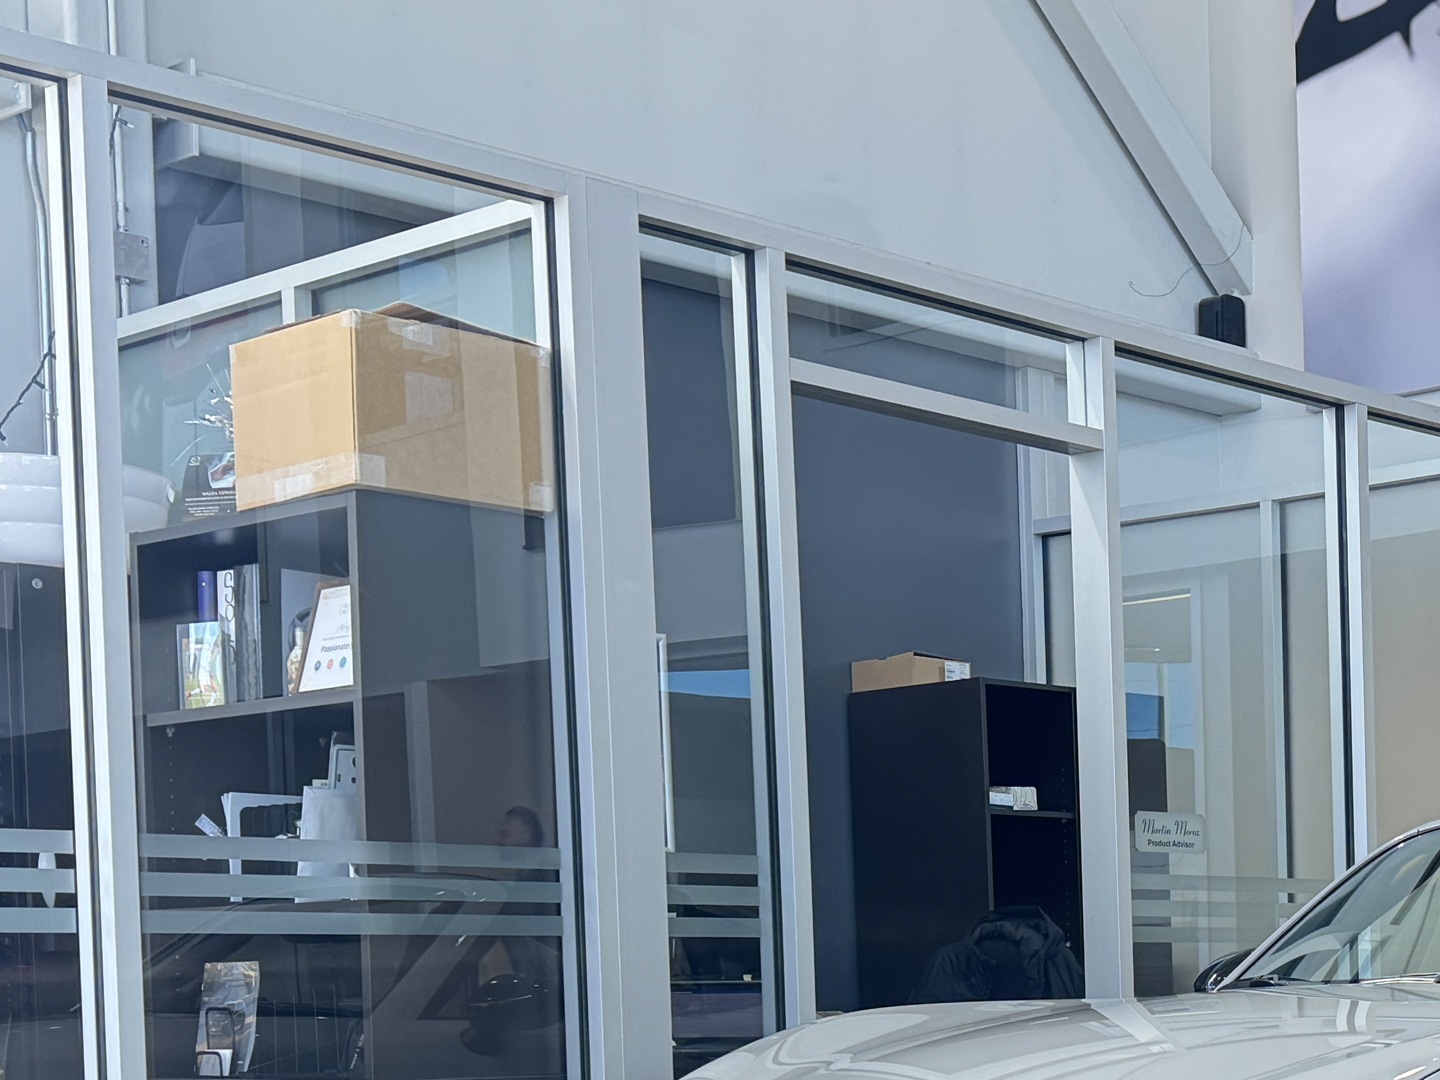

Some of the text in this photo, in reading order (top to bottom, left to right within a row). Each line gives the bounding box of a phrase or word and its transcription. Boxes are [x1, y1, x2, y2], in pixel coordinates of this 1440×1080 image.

[1141, 818, 1171, 835] Martin
[1147, 838, 1195, 849] Product Advisor
